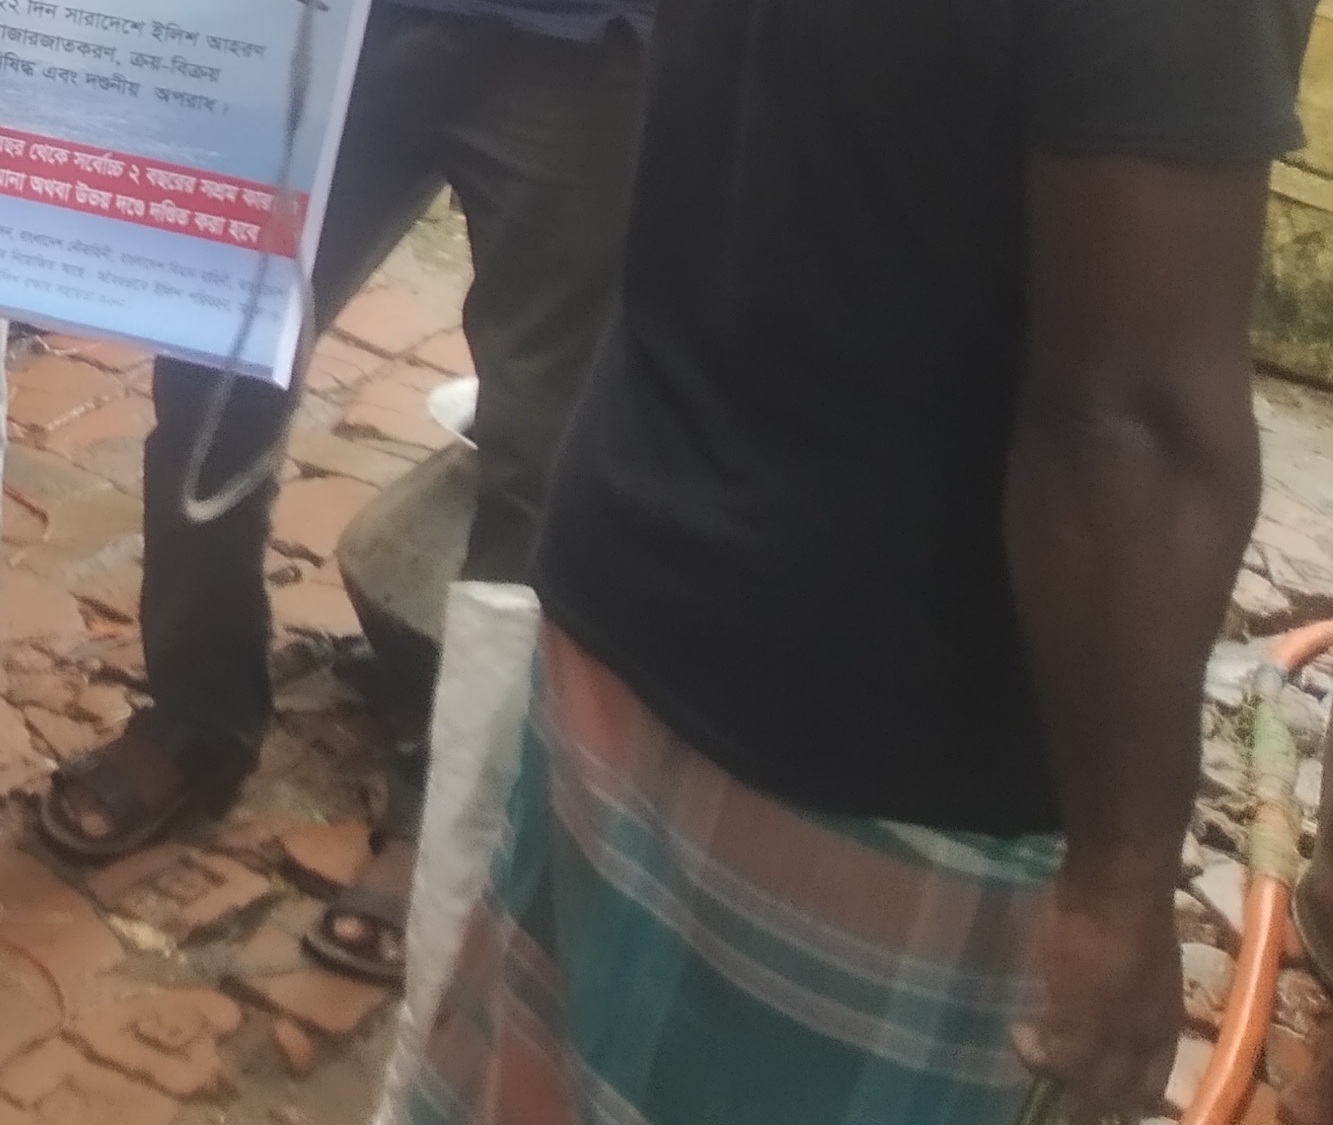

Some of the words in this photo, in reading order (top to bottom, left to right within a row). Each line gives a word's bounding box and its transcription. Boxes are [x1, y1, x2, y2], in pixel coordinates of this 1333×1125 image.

[64, 6, 145, 35] সারাদেশে
[151, 19, 200, 46] ইলিশ
[129, 50, 221, 82] ক্রয়-বিক্রয়
